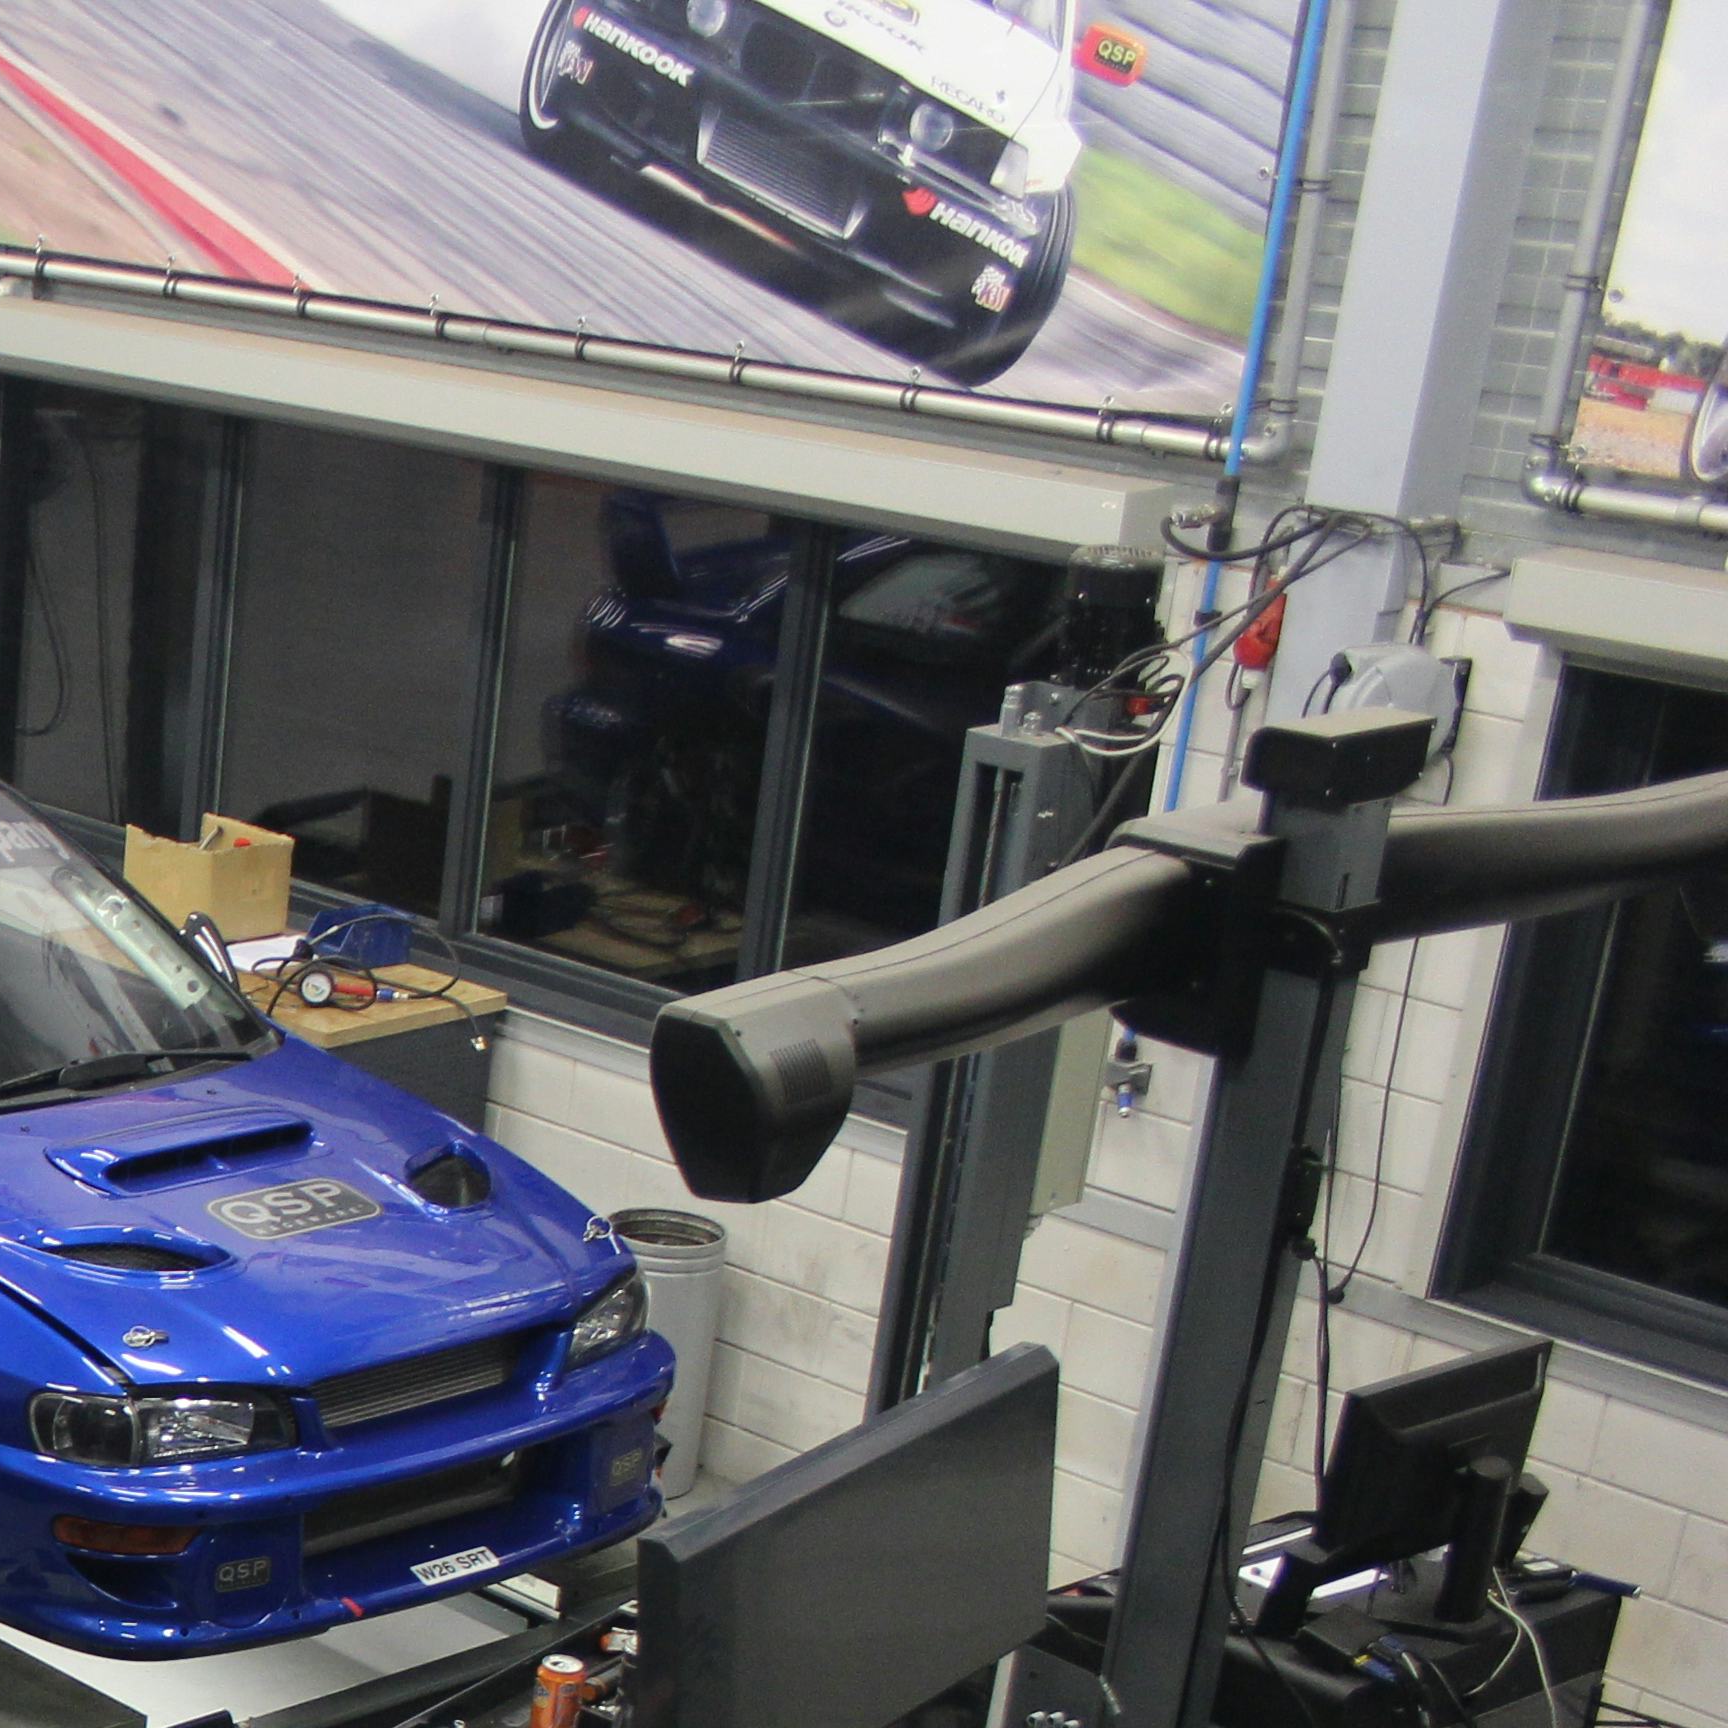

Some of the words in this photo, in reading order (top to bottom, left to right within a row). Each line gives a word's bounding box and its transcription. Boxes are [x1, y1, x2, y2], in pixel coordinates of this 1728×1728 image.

[1098, 40, 1137, 65] QSP
[220, 1182, 342, 1225] QSP
[218, 1559, 268, 1583] QSP
[415, 1556, 454, 1582] W26
[455, 1547, 495, 1571] SRT
